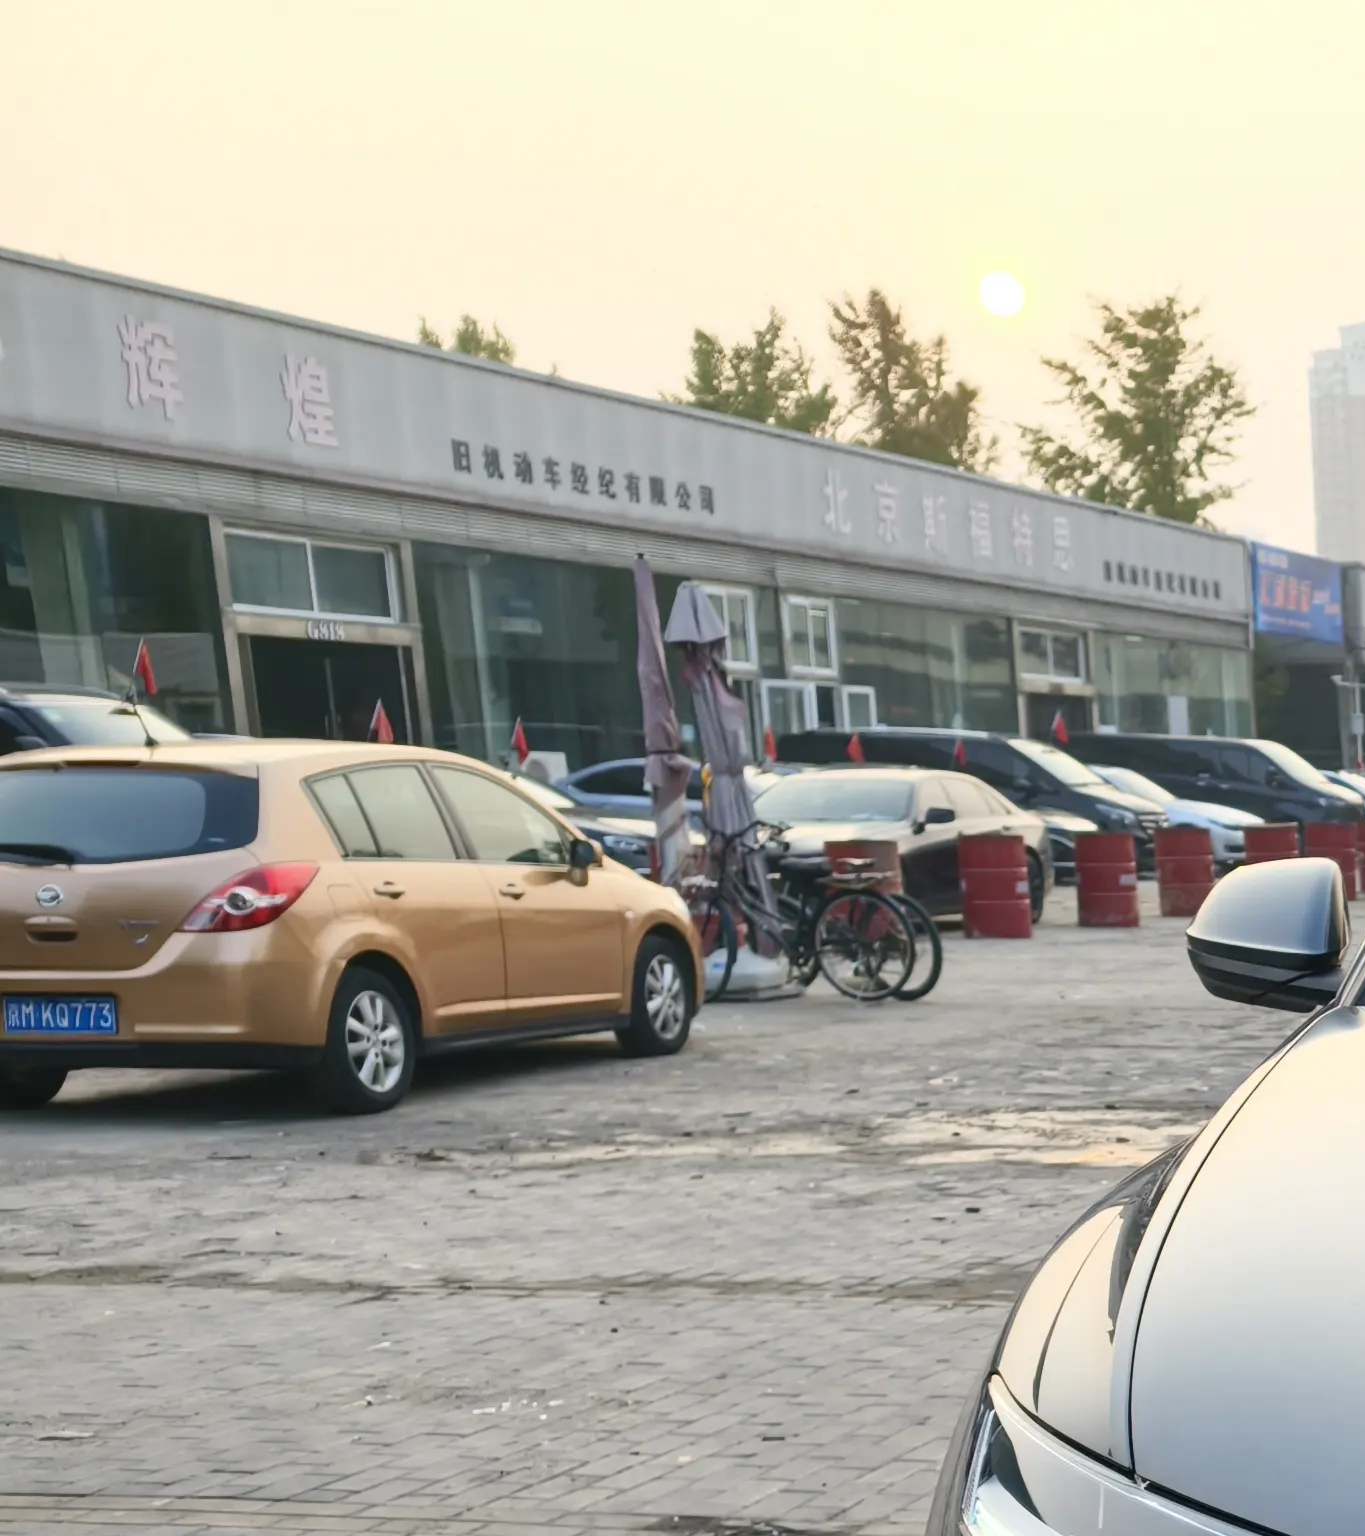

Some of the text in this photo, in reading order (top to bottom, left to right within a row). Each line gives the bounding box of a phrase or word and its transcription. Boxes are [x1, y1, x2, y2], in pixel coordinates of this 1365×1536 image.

[117, 313, 339, 447] 辉煌
[451, 438, 715, 515] 旧机动车经纪有限公司
